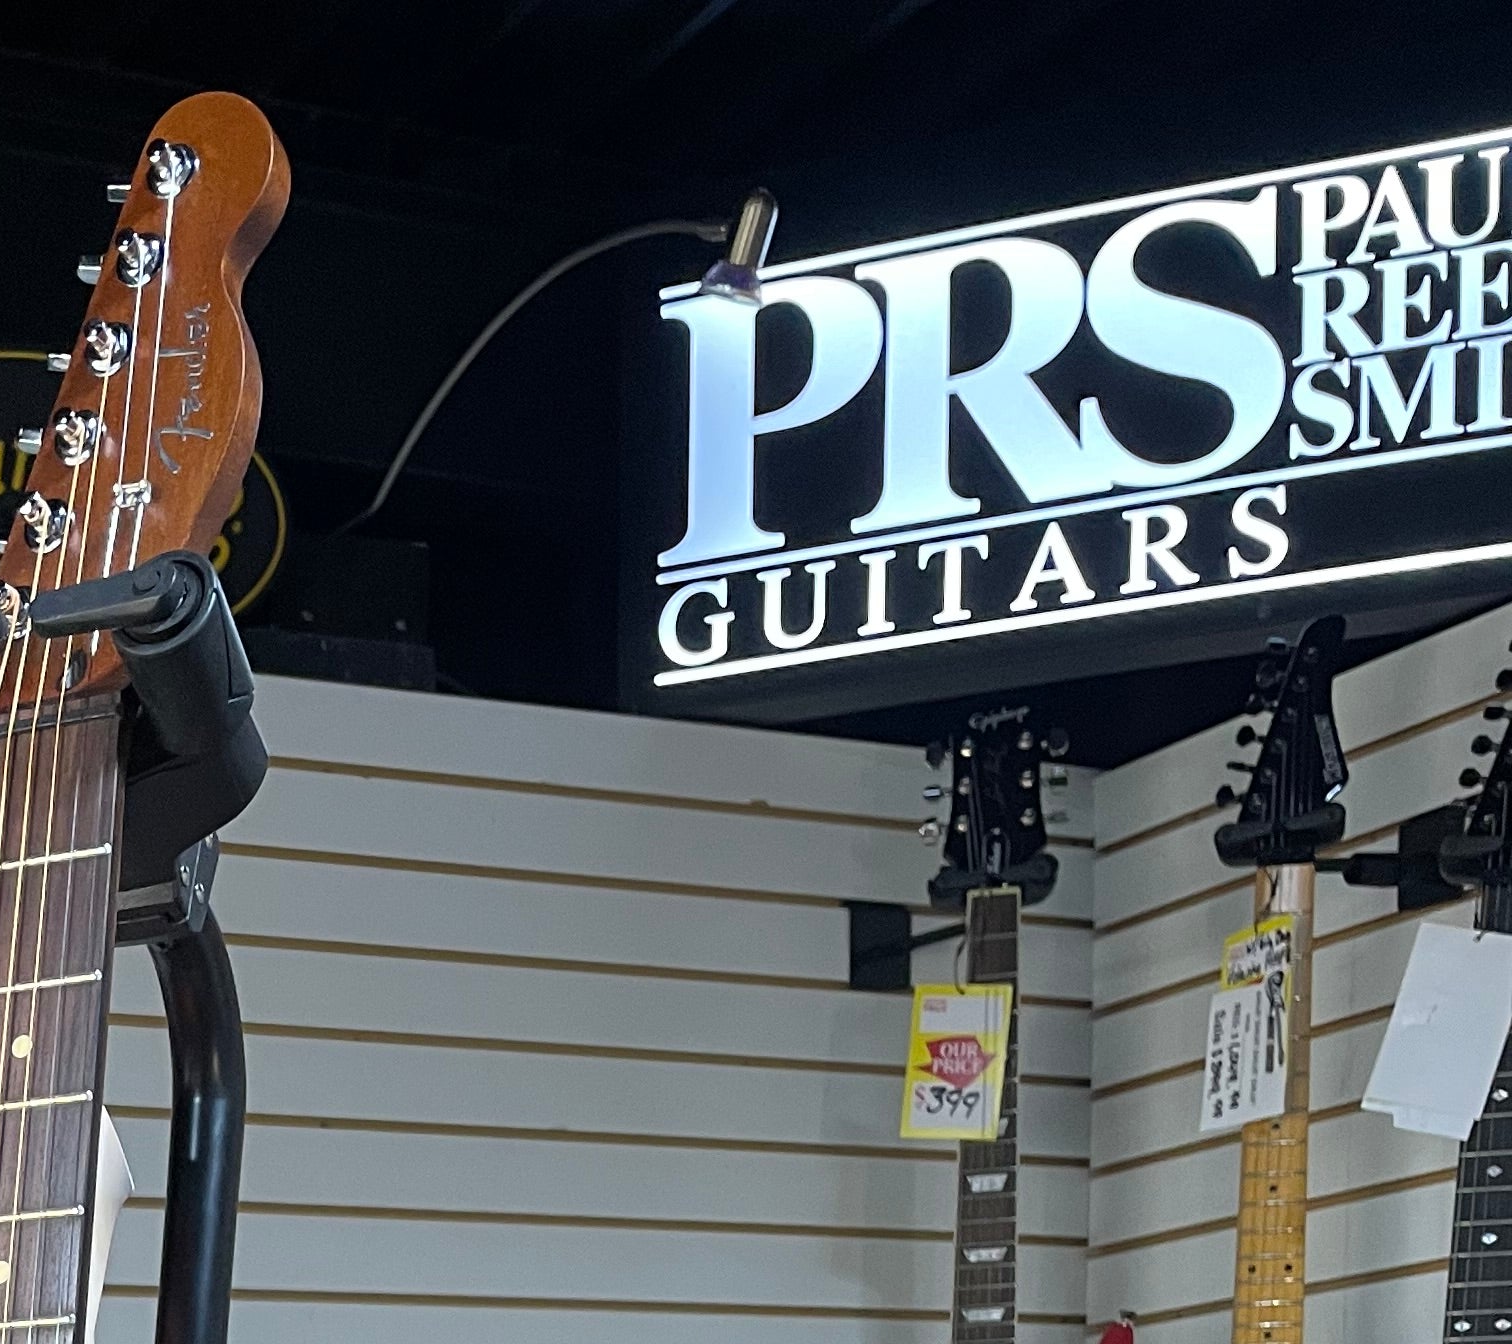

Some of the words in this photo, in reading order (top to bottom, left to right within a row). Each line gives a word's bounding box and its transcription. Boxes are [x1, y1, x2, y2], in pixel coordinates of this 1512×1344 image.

[1292, 146, 1510, 274] PAU
[1293, 240, 1512, 367] REE
[155, 302, 214, 475] Fender
[656, 182, 1288, 568] PRS
[1289, 334, 1512, 460] SMI
[654, 484, 1289, 667] GUITARS
[931, 1057, 987, 1075] PRICE
[939, 1041, 980, 1059] OUR
